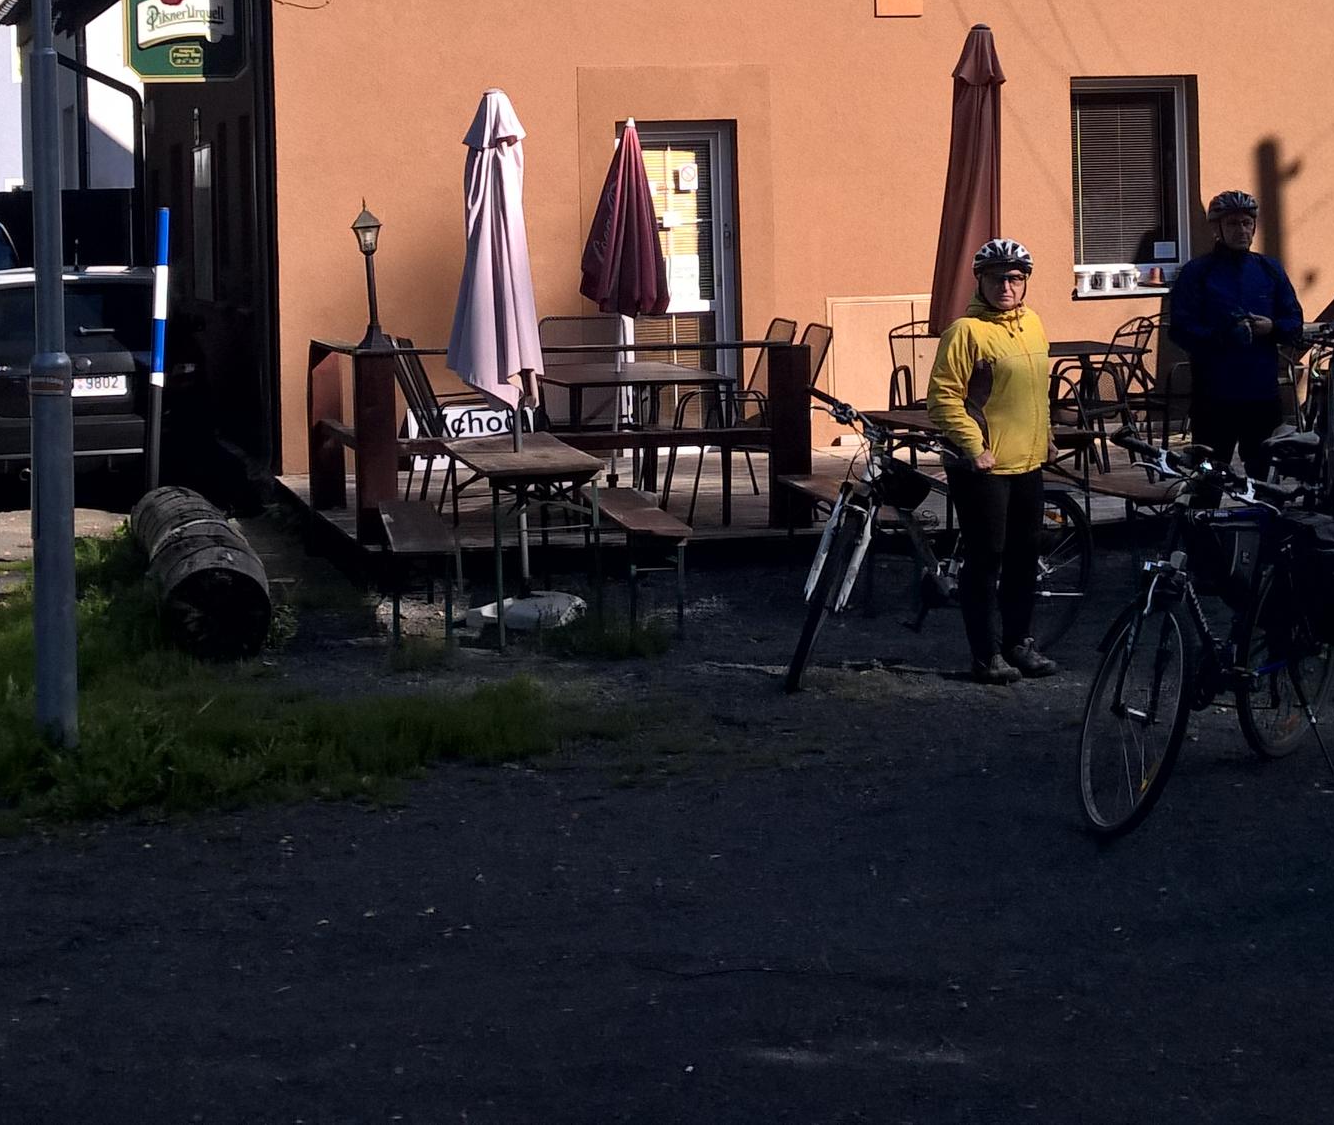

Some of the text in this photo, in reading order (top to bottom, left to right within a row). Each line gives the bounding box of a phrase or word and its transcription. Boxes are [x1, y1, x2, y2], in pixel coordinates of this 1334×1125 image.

[146, 3, 225, 32] Pilsner Urquell
[85, 376, 119, 389] 9802
